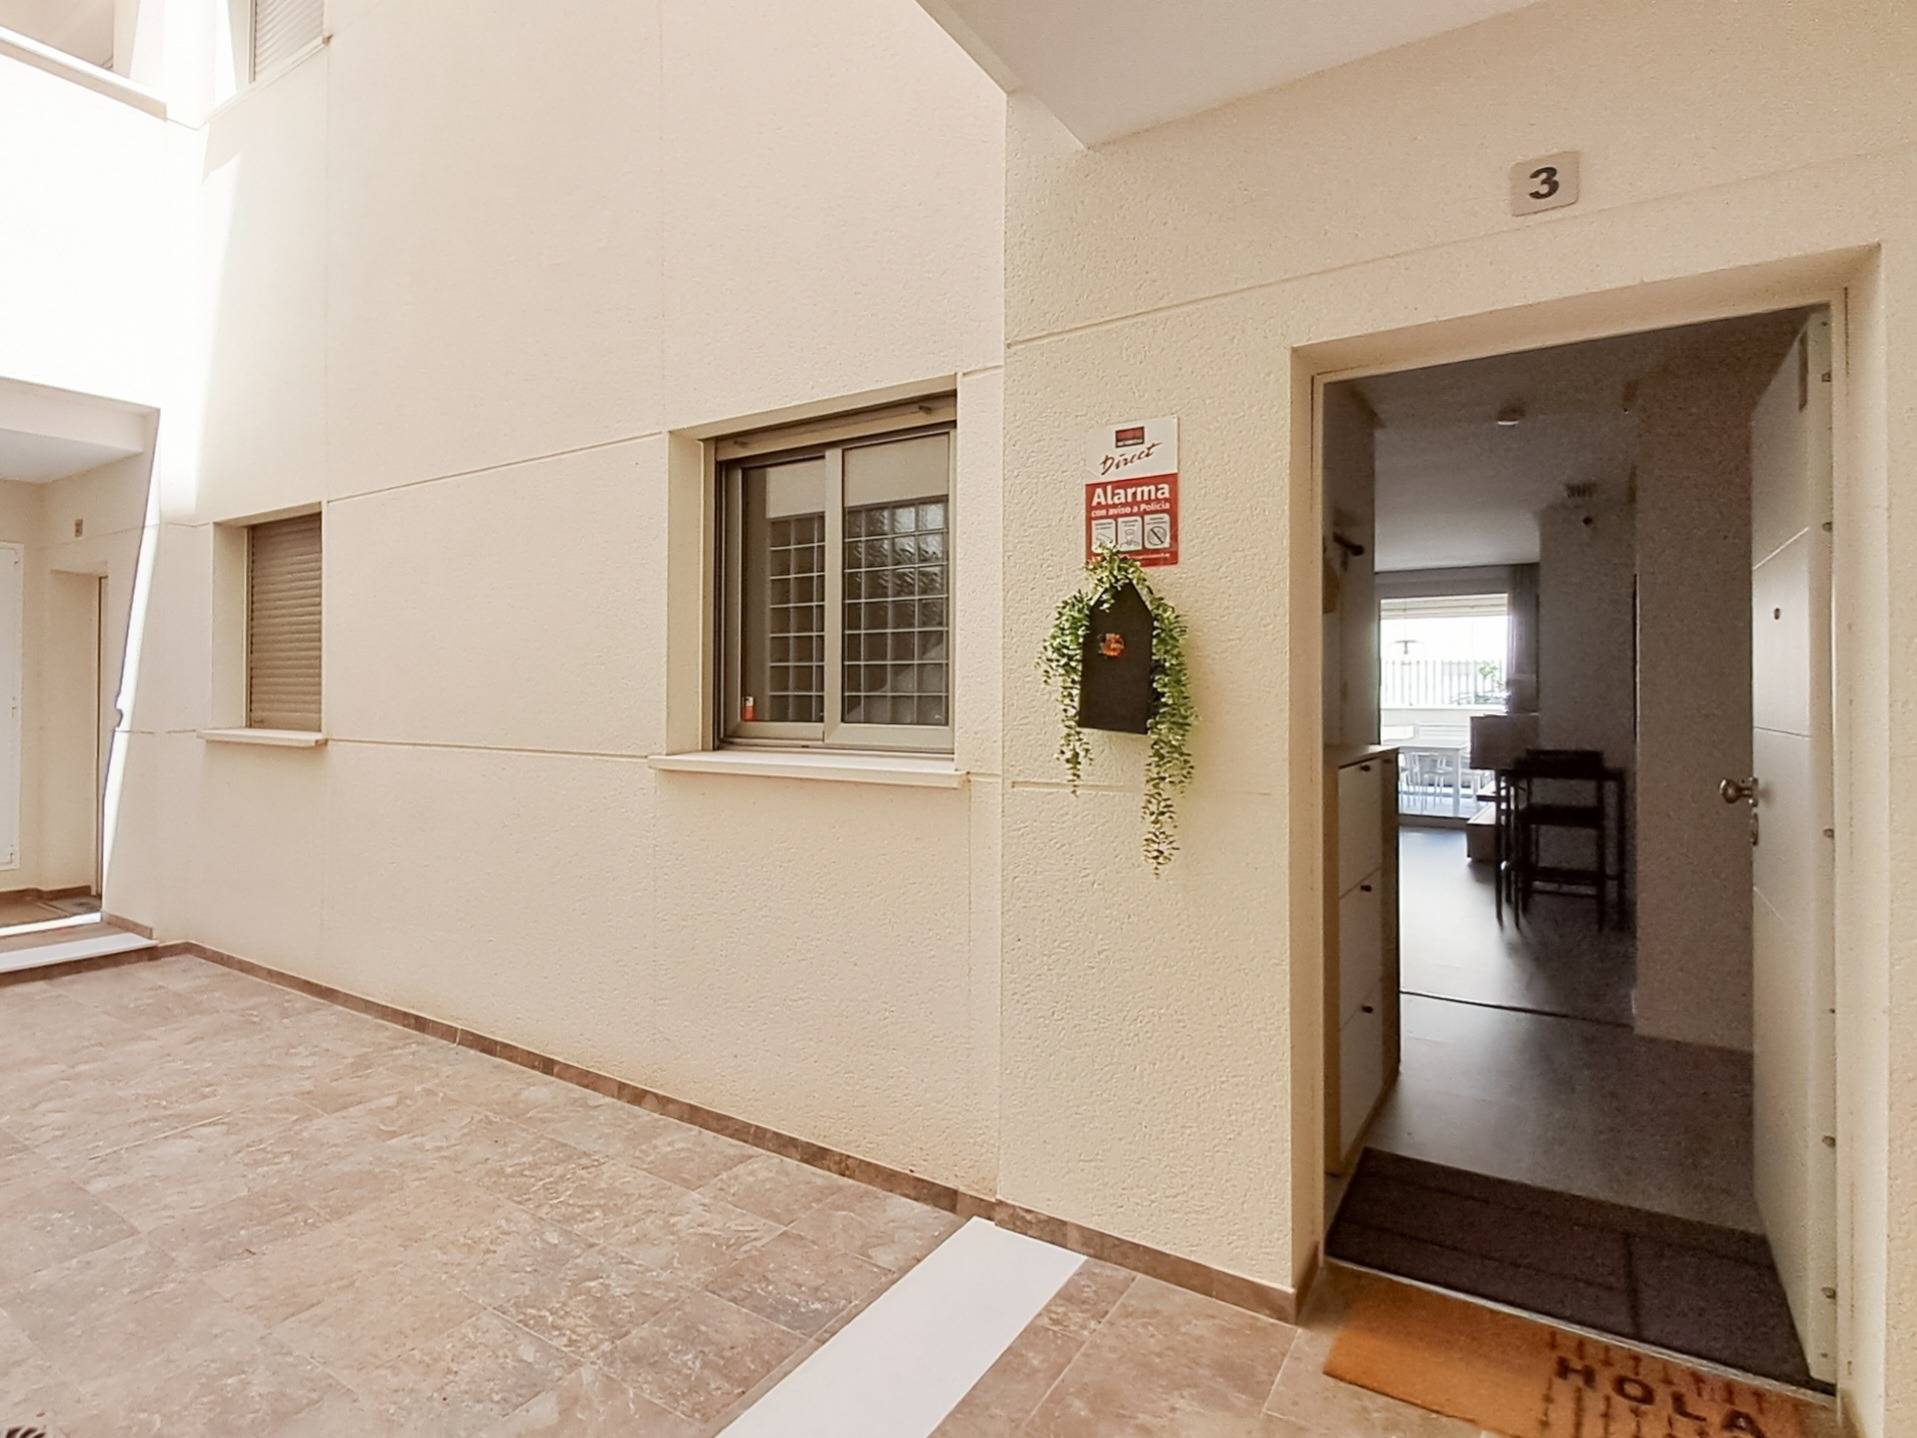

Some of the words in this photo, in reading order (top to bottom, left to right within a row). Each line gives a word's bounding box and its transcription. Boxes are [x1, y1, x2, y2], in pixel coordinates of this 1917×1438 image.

[1529, 167, 1559, 199] 3
[1099, 442, 1162, 475] Direct
[1091, 484, 1170, 507] Alarma
[1108, 505, 1131, 516] aviso
[1555, 1355, 1767, 1438] HOLA
